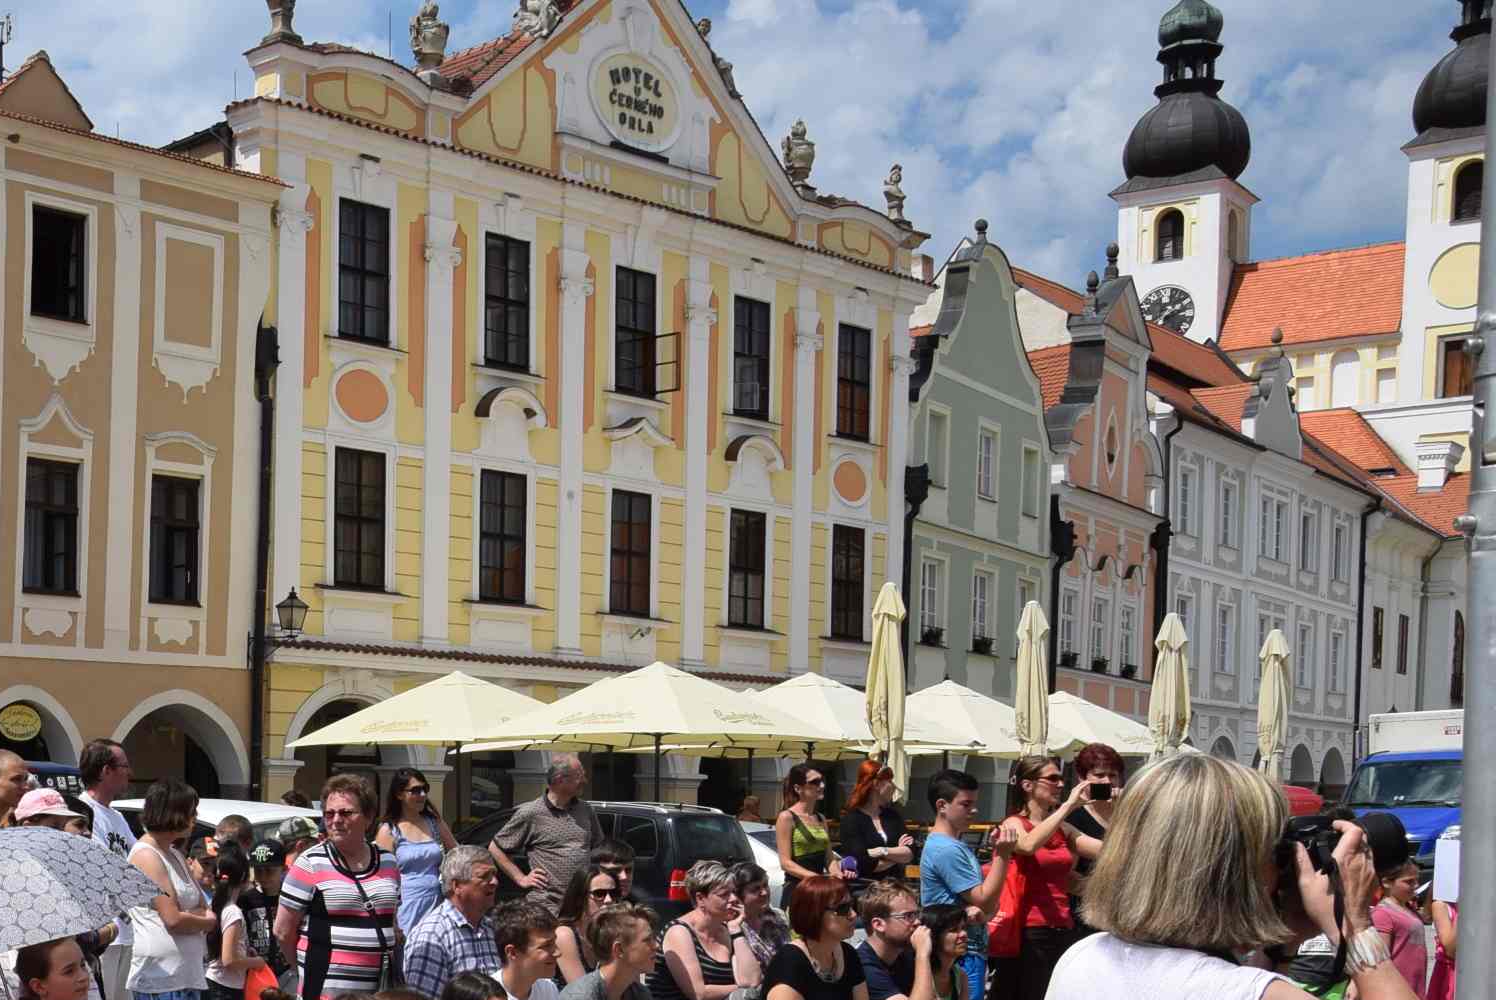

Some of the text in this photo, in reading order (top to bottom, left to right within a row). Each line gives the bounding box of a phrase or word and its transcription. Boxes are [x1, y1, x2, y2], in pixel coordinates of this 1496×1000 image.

[609, 66, 662, 98] HOTEL
[633, 86, 641, 97] U
[609, 87, 664, 119] ČERNÉHO
[619, 112, 654, 134] ORLA
